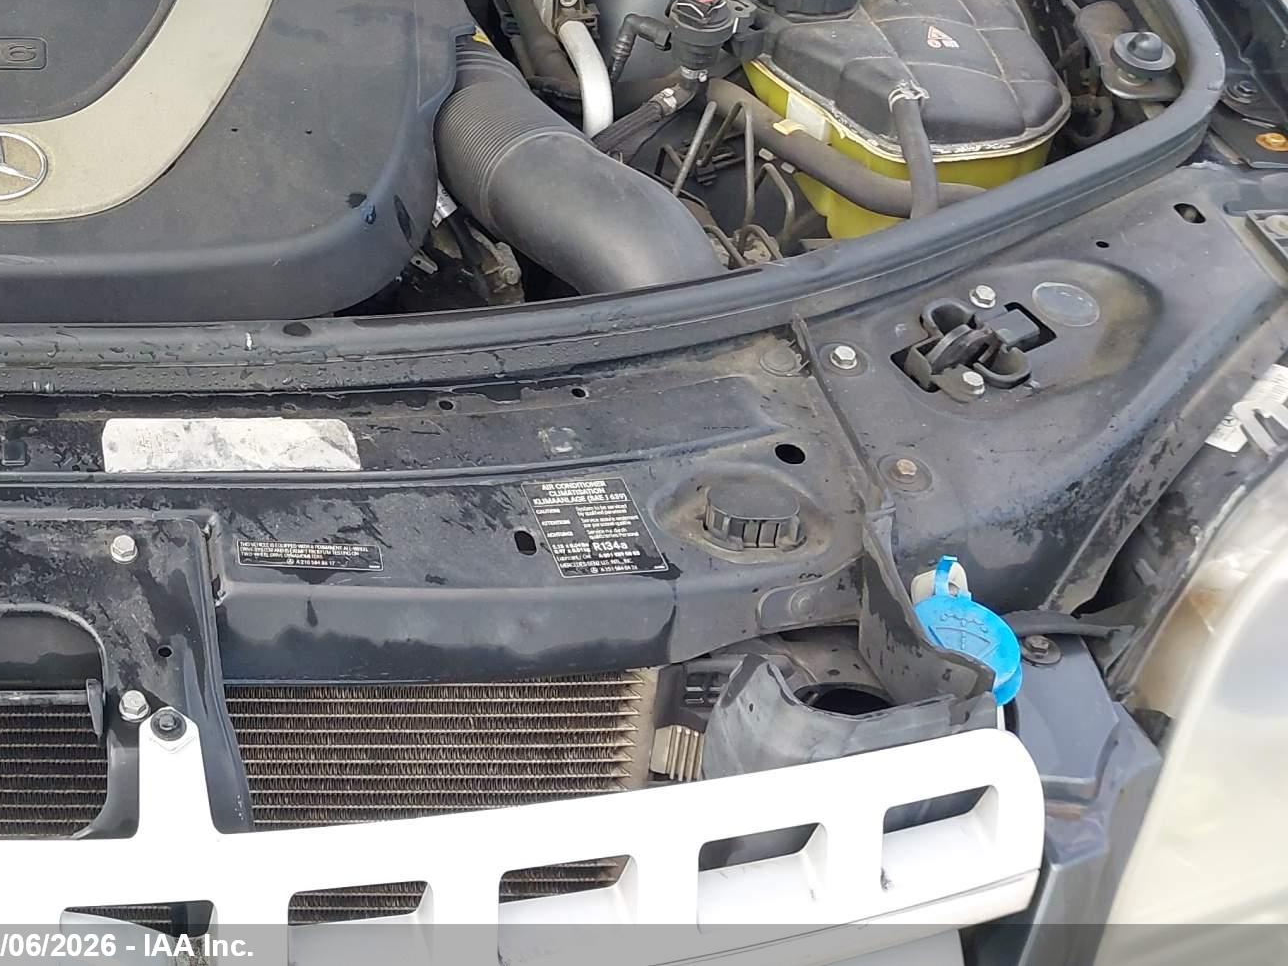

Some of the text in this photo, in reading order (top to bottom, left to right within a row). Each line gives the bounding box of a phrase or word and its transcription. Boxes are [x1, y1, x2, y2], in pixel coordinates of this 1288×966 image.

[555, 481, 607, 489] CONDITIONER
[532, 496, 586, 505] KLIMAANLAGE
[592, 540, 628, 551] R134a
